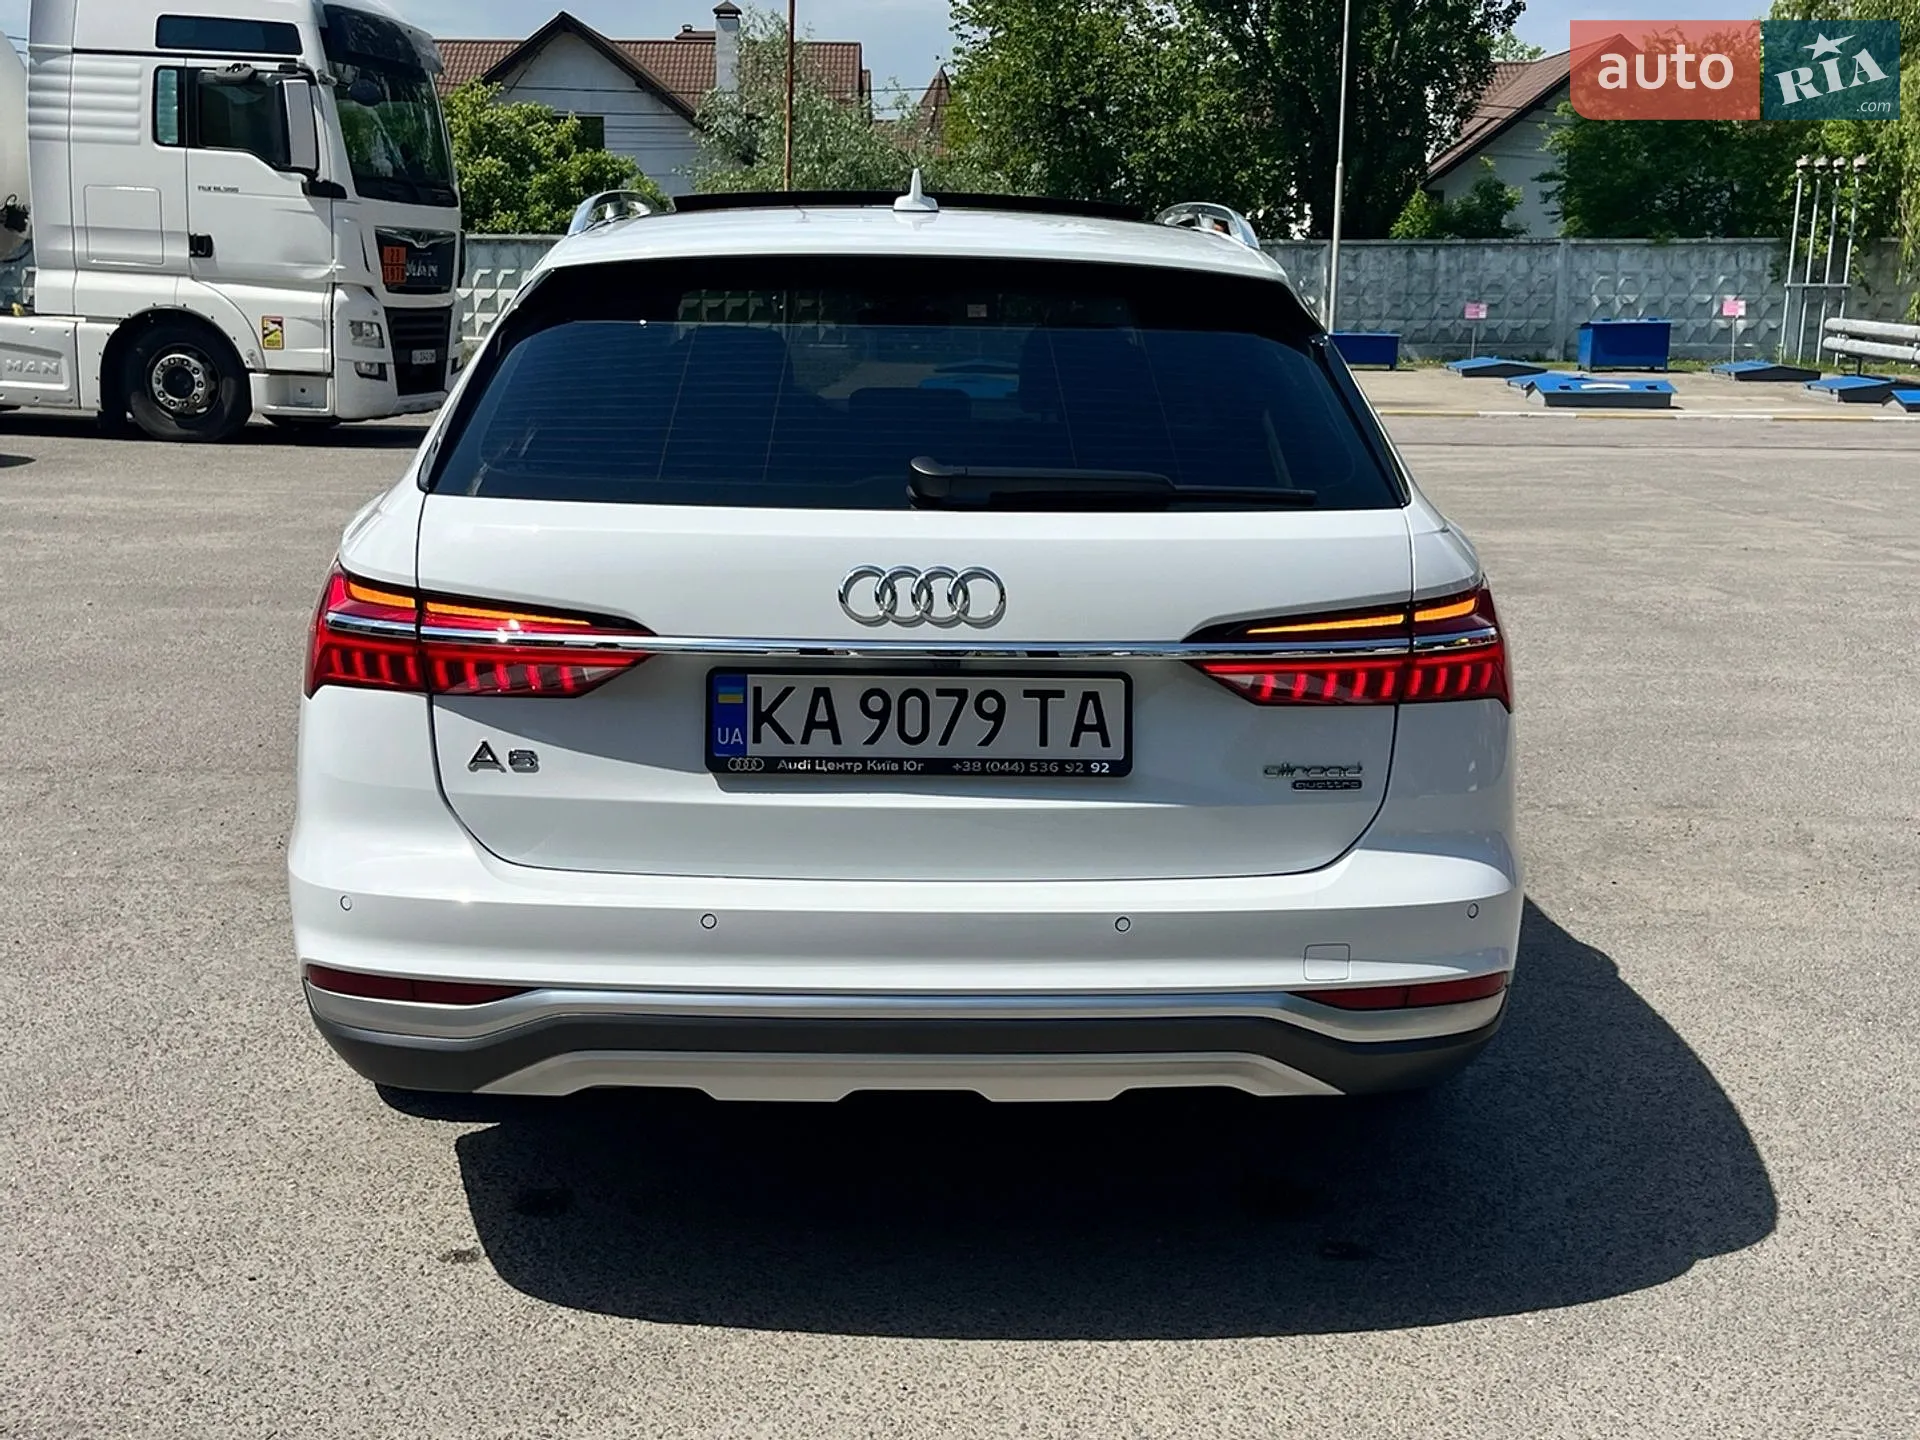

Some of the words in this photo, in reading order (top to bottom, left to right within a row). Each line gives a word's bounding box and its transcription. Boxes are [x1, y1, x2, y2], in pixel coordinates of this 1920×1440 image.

[405, 260, 439, 277] MAN
[6, 359, 60, 375] MAN
[752, 686, 843, 746] KA
[859, 687, 1007, 747] 9079
[1022, 689, 1112, 748] TA
[717, 727, 744, 745] UA
[467, 740, 540, 774] A6
[777, 759, 811, 771] Audi
[815, 759, 863, 773] Центр
[867, 759, 899, 771] Київ
[903, 760, 924, 772] Юг
[952, 761, 982, 772] +38
[986, 761, 1025, 773] (044)
[1029, 762, 1059, 773] 536
[1064, 762, 1085, 773] 92
[1090, 762, 1110, 774] 92
